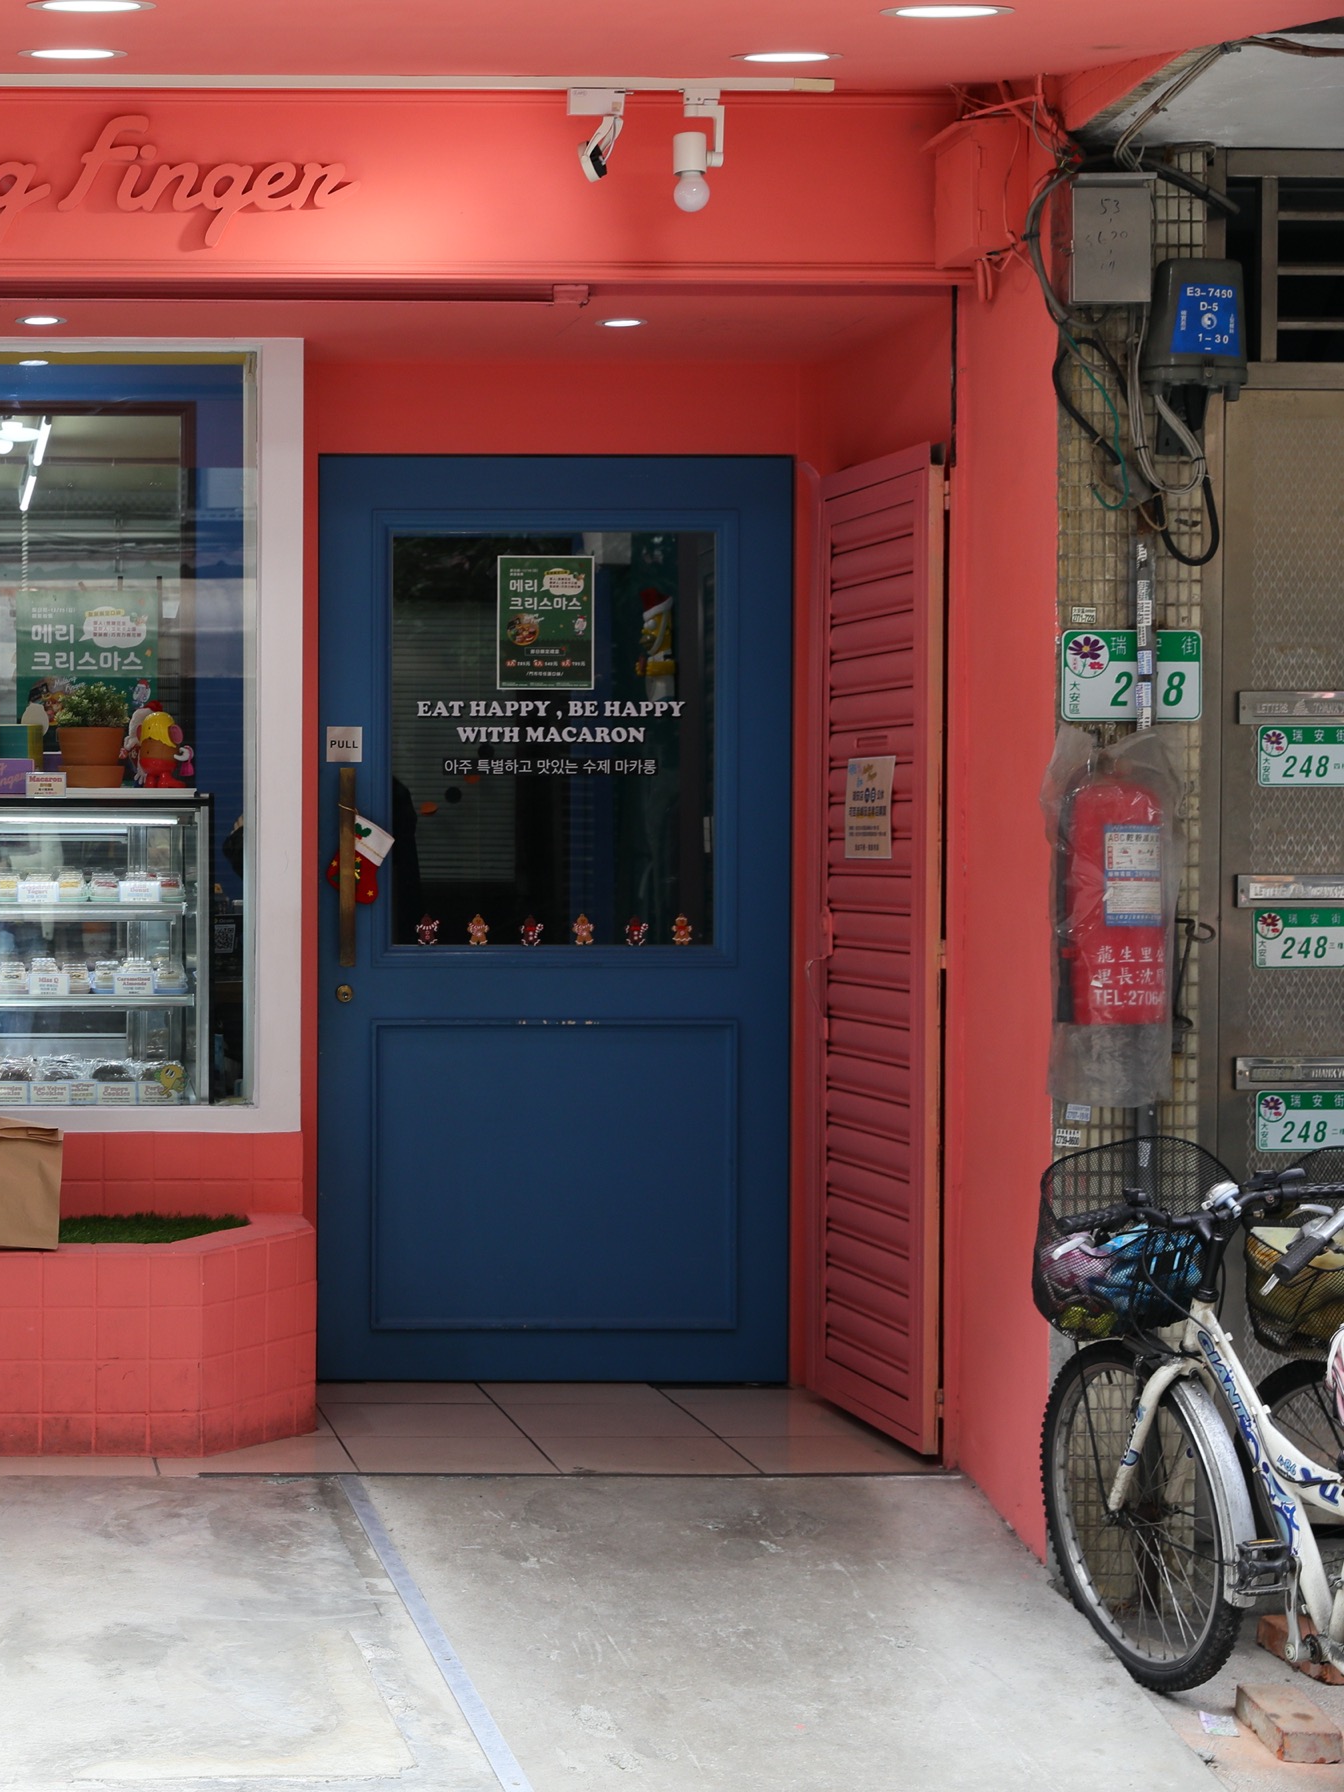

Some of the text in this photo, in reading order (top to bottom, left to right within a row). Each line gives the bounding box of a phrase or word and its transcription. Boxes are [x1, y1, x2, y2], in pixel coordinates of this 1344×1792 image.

[509, 579, 537, 593] 메리
[509, 597, 582, 610] 크리스마스
[31, 624, 74, 644] 메리
[1111, 636, 1197, 655] 瑞街
[31, 651, 143, 671] 크리스마스
[1110, 671, 1186, 707] 28
[416, 701, 464, 717] EAT
[469, 701, 551, 717] HAPPY
[568, 701, 599, 717] BE
[603, 701, 685, 717] HAPPY
[330, 740, 358, 748] PULL
[456, 727, 646, 743] WITH MACARON
[444, 759, 657, 774] 아주 특별하고 맛있는 수제 마카롱
[1282, 755, 1330, 777] 248
[1281, 936, 1328, 959] 248
[1291, 1094, 1344, 1107] 瑞安街
[1280, 1121, 1328, 1143] 248
[1197, 1330, 1252, 1425] GIANT
